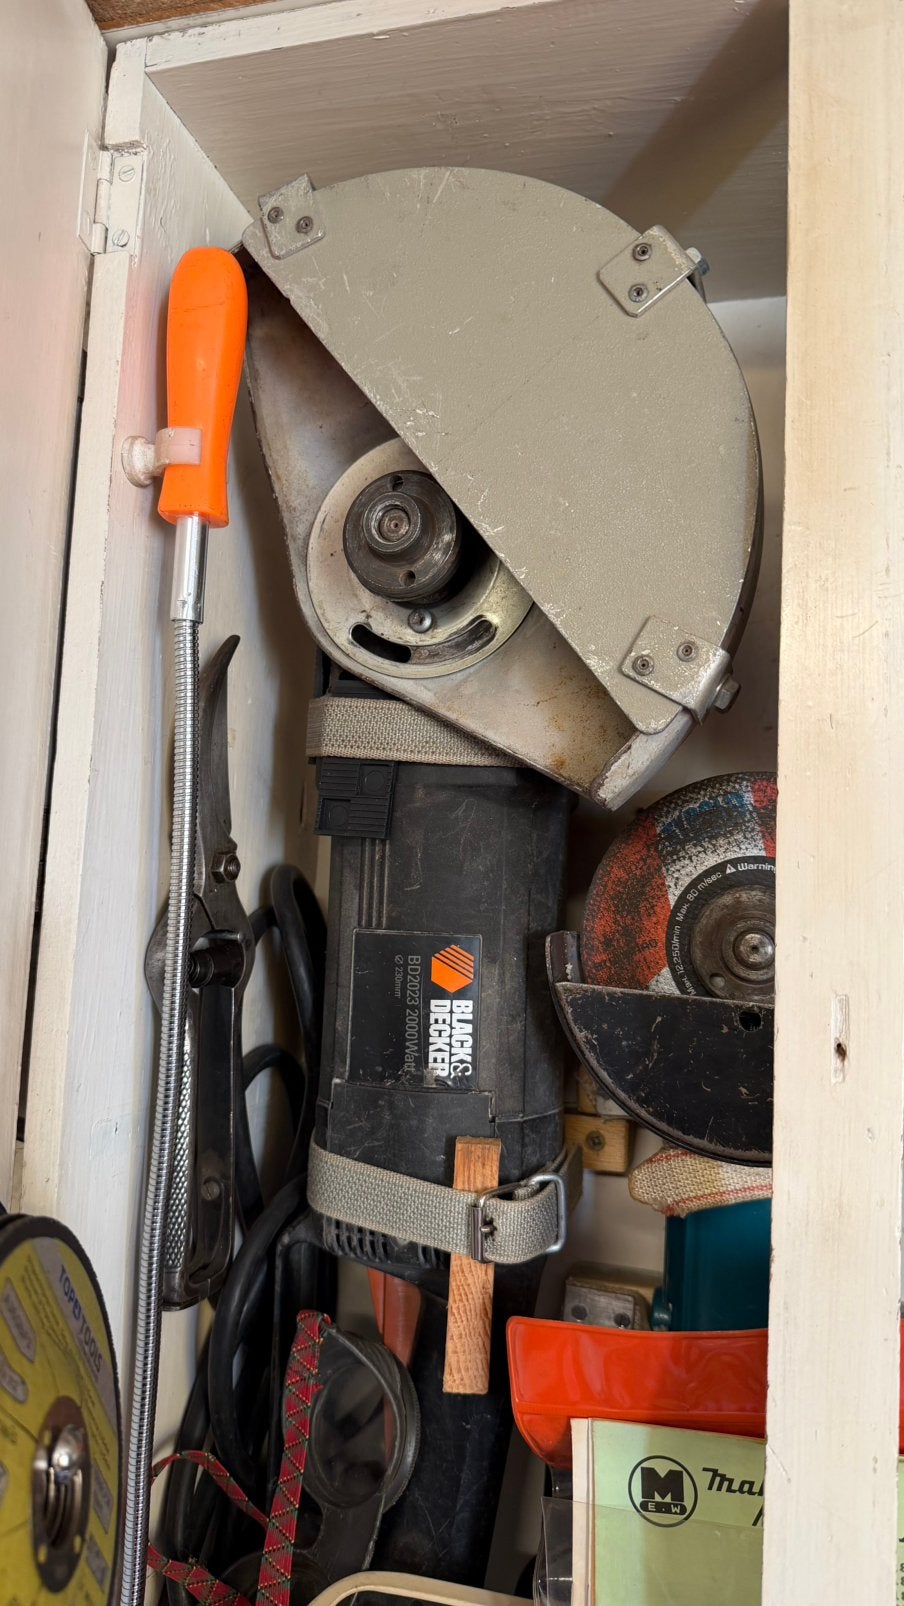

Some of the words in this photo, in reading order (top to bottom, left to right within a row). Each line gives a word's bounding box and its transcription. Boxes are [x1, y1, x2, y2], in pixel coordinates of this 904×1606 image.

[686, 888, 699, 902] 80
[697, 871, 722, 891] m/sec
[394, 966, 403, 999] 230mm
[406, 954, 421, 1006] BD2023
[404, 1008, 419, 1073] 2000Watt
[428, 999, 451, 1078] DECKER
